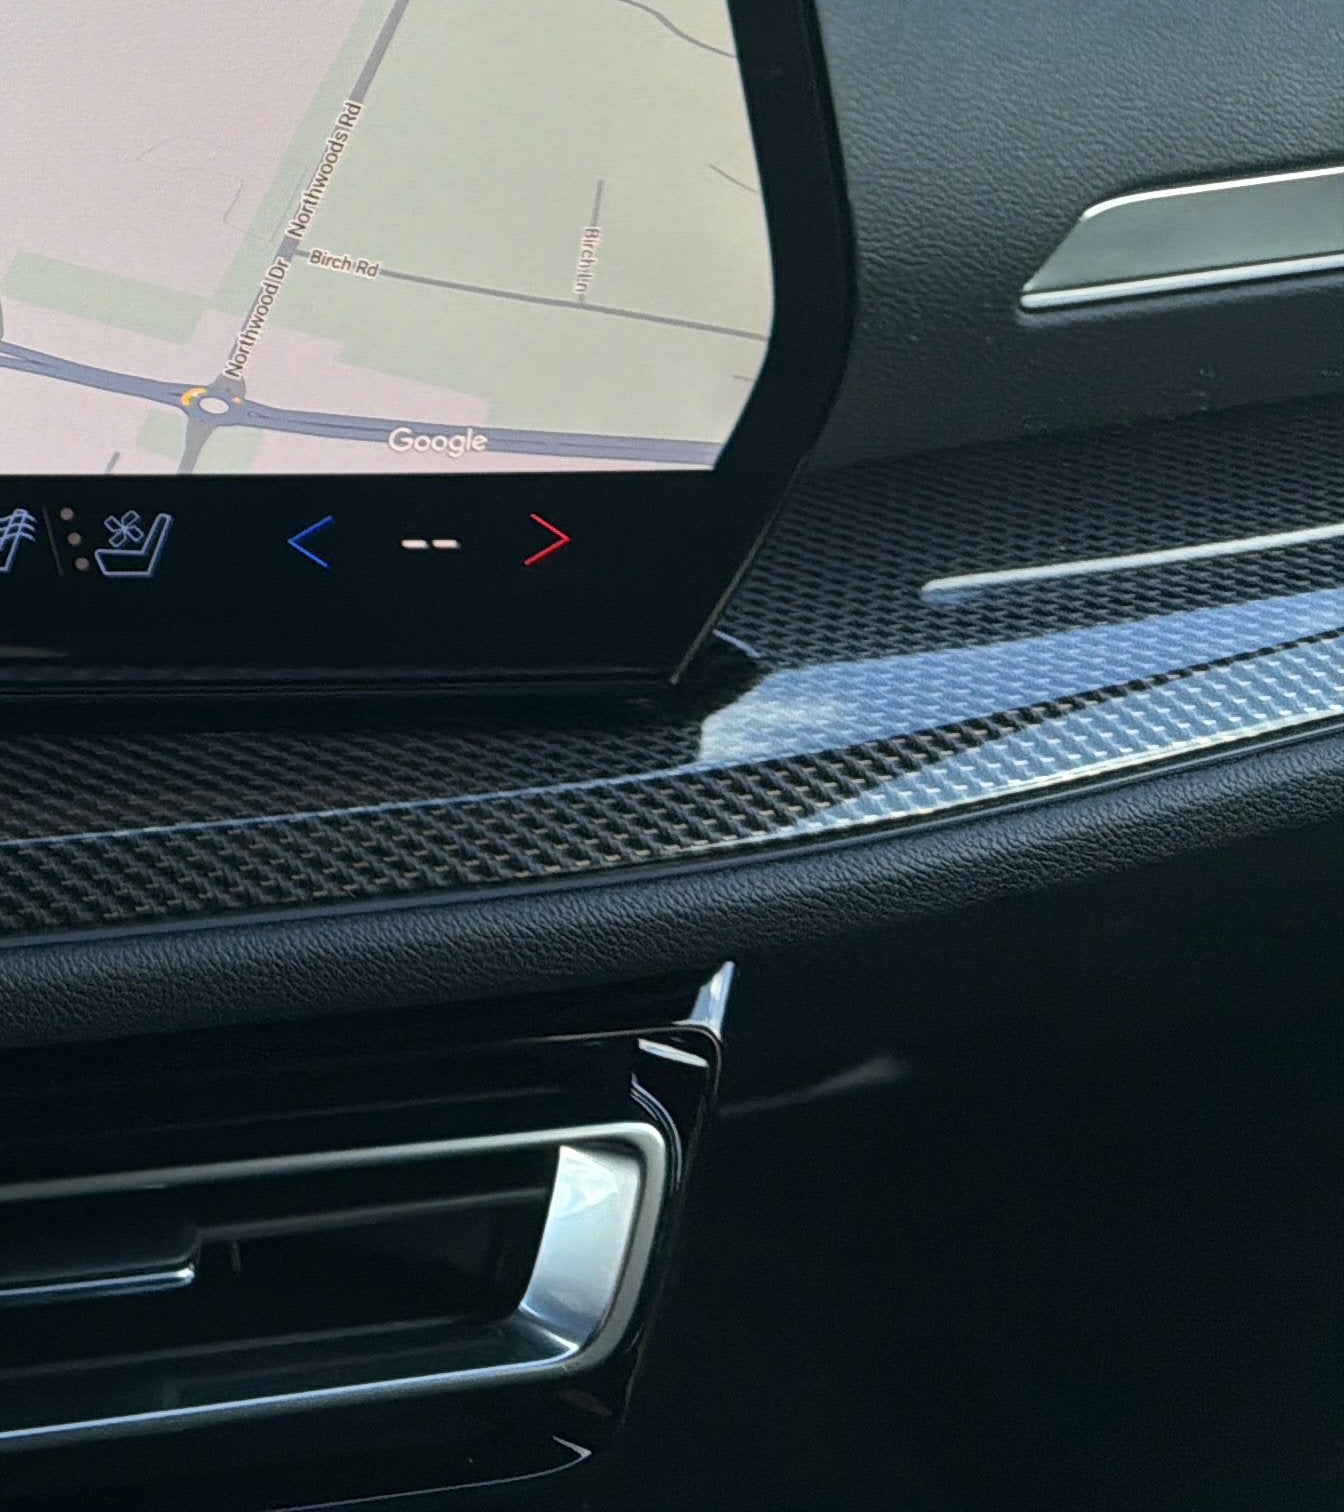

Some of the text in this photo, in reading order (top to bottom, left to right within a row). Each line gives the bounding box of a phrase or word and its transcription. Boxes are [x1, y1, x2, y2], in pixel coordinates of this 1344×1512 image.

[287, 102, 362, 239] Northwoods Rd
[309, 249, 379, 278] Birch Rd
[574, 228, 600, 294] Birch Ln
[225, 259, 290, 379] Northwood Dr
[389, 428, 488, 457] Google
